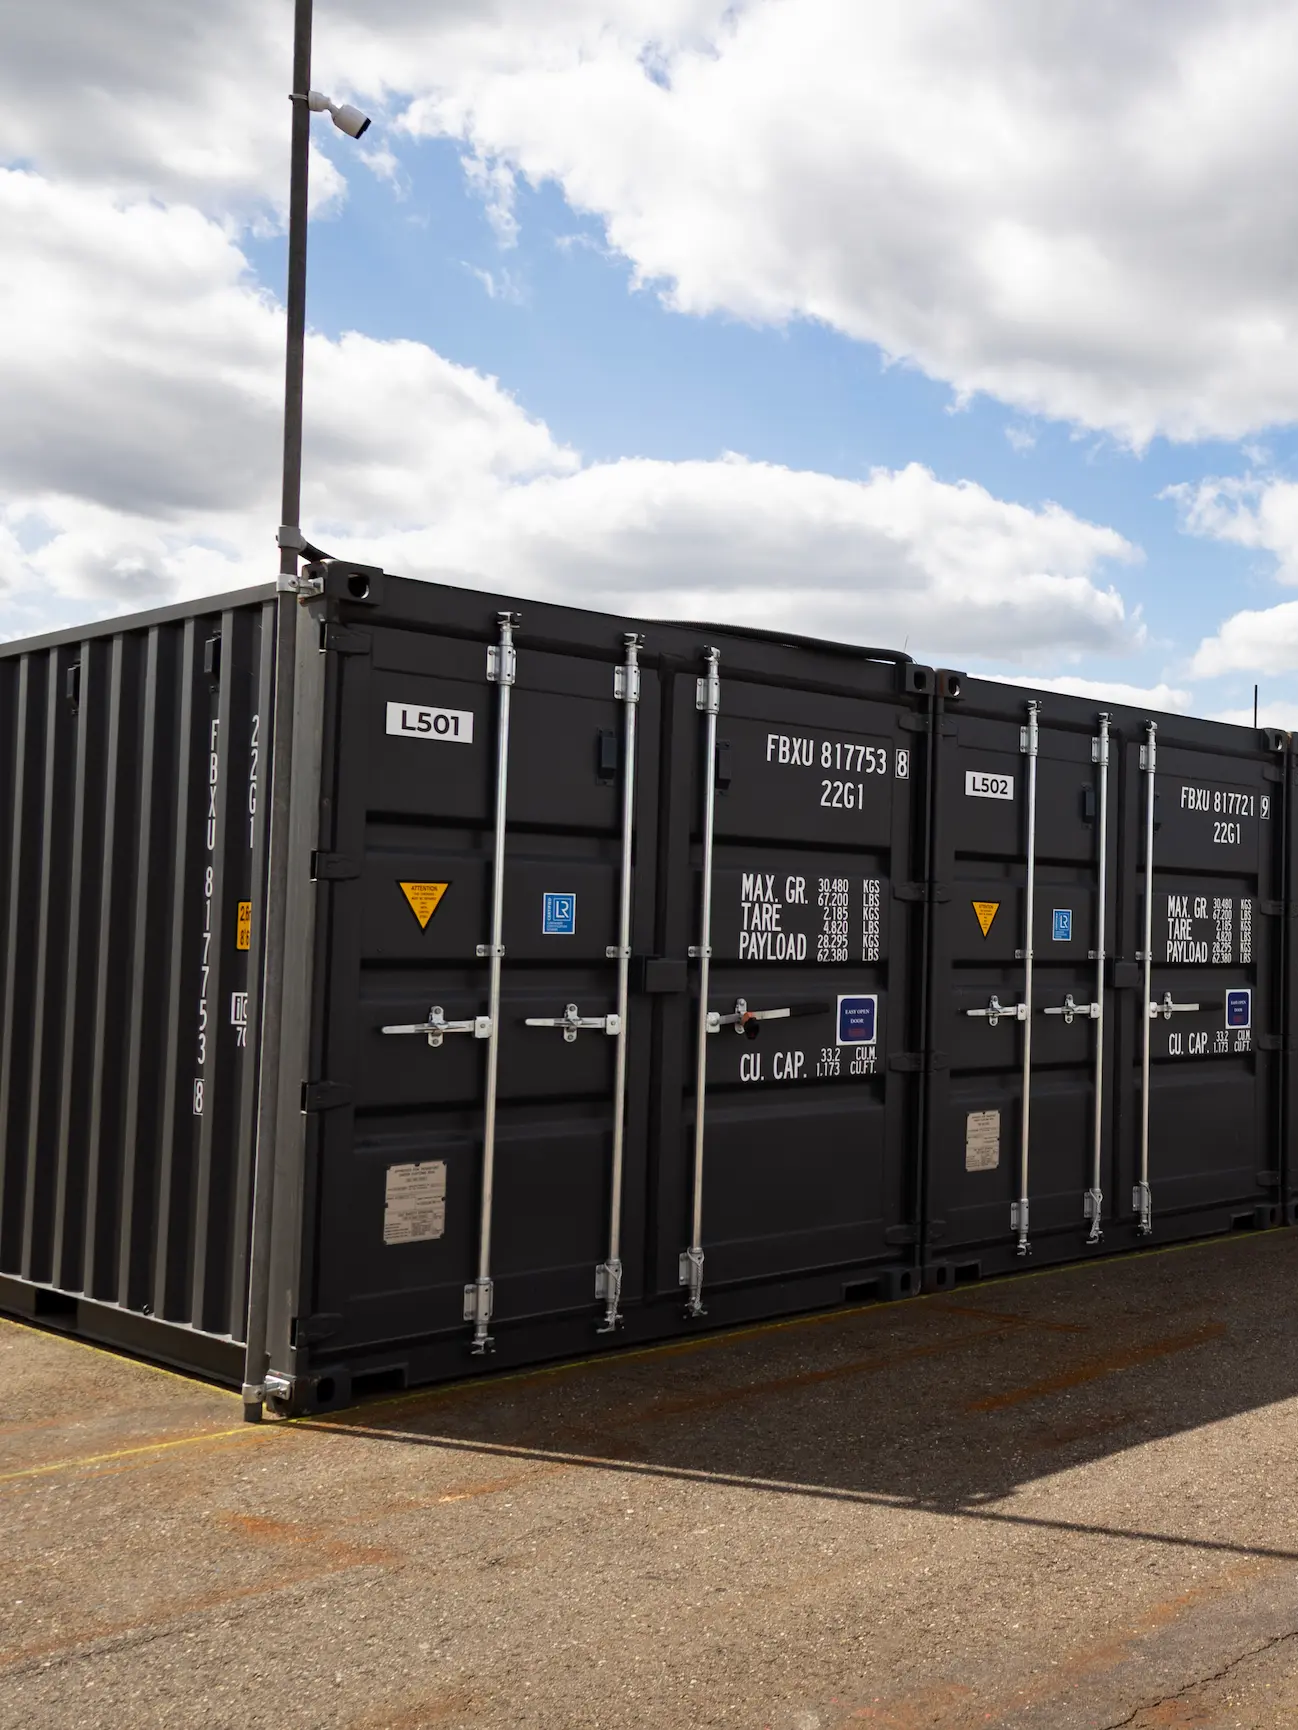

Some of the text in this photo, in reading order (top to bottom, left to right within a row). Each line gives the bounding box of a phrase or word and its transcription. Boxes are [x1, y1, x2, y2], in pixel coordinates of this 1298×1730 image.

[401, 709, 459, 736] L501
[766, 733, 908, 778] FBXU 817753 8
[249, 714, 260, 849] 22G1
[972, 776, 1008, 794] L502
[820, 780, 864, 810] 22G1
[1180, 786, 1270, 818] FBXU 817721 9
[1213, 822, 1240, 844] 22G1
[741, 872, 880, 904] MAX. GR. 30.480 KGS
[556, 900, 570, 918] LR
[818, 893, 880, 907] 67.200 LBS
[1167, 895, 1190, 918] MAX.
[1194, 896, 1208, 918] GR.
[1240, 898, 1252, 910] KGS
[195, 718, 220, 1113] FBXU 817753 8
[741, 902, 880, 932] TARE 2.185 KGS
[1060, 915, 1069, 928] LR
[1240, 910, 1252, 921] LBS
[823, 920, 880, 934] 4.820 LBS
[1167, 918, 1192, 940] TARE
[1240, 920, 1252, 932] KGS
[1240, 931, 1252, 942] LBS
[739, 932, 880, 960] PAYLOAD 28.295 KGS
[817, 948, 880, 962] 62.380 LBS
[1166, 940, 1208, 963] PAYLOAD
[1240, 942, 1252, 953] KGS
[1240, 952, 1252, 964] LBS
[1168, 1033, 1184, 1055] CU.
[1188, 1032, 1210, 1054] CAP.
[1216, 1031, 1229, 1042] 33.2
[1214, 1042, 1228, 1053] 1.173
[740, 1046, 878, 1082] CU. CAP. 33.2 CU.M.
[816, 1060, 877, 1077] 1.173 CU.FT.
